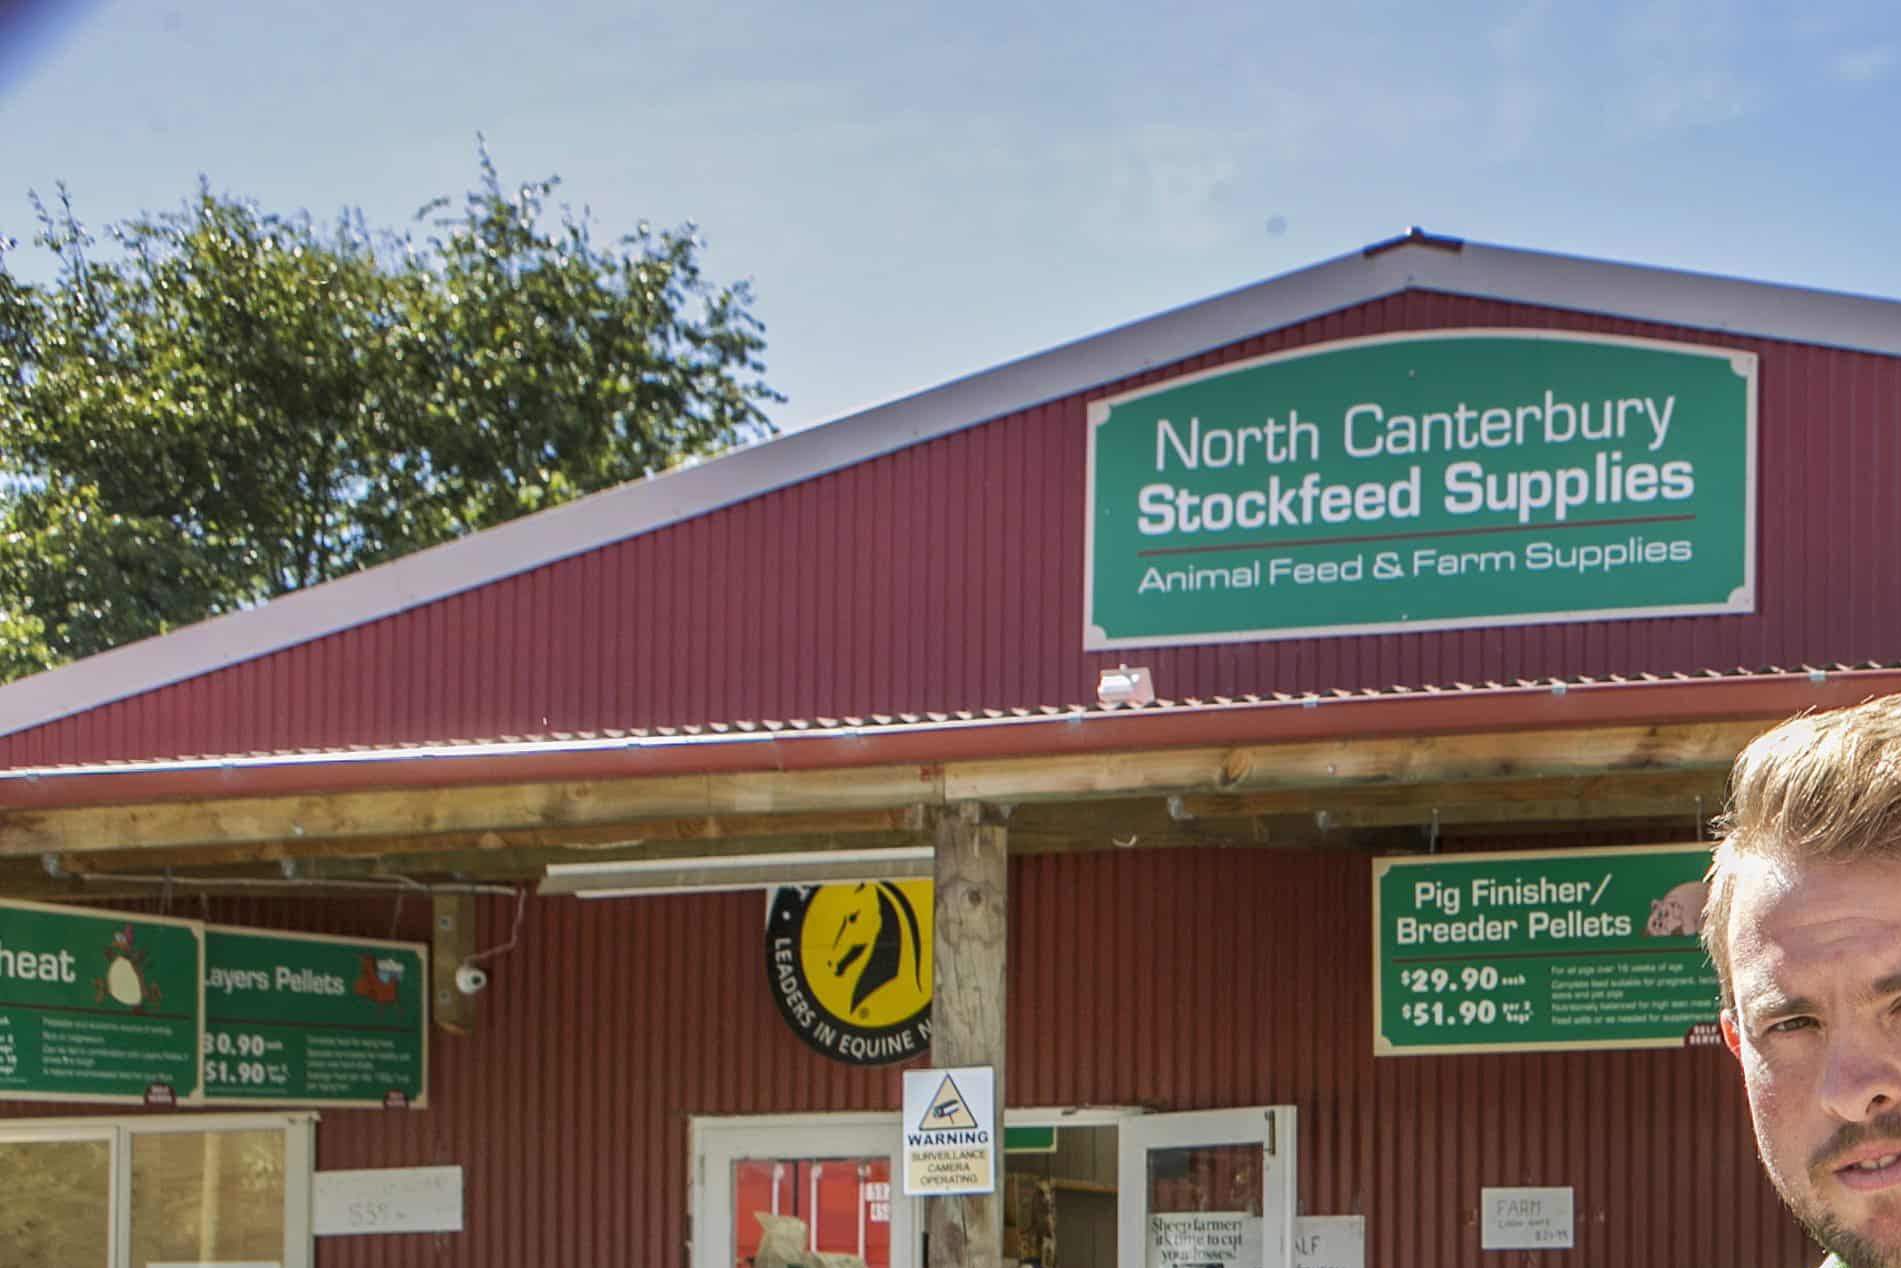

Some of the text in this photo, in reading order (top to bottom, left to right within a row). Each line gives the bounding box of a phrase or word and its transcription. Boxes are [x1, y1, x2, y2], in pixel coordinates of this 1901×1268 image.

[1156, 390, 1675, 470] North Canterbury
[1138, 451, 1695, 535] Stockfeed Supplies
[1138, 537, 1692, 594] Animal Feed & Farm Supplies
[1415, 873, 1612, 915] Pig Finisher/
[1397, 911, 1632, 944] Breeder Pellets
[205, 966, 345, 996] ayers Pellets
[1401, 966, 1498, 994] $29.90
[775, 938, 816, 1028] LEADERS
[813, 1022, 837, 1048] IN
[839, 1030, 915, 1058] EQUINE
[1402, 1001, 1497, 1027] $51.90
[908, 1131, 989, 1146] WARNING
[911, 1150, 986, 1161] SURVEILLANCE
[928, 1163, 971, 1173] CAMERA
[920, 1174, 978, 1185] OPERATING
